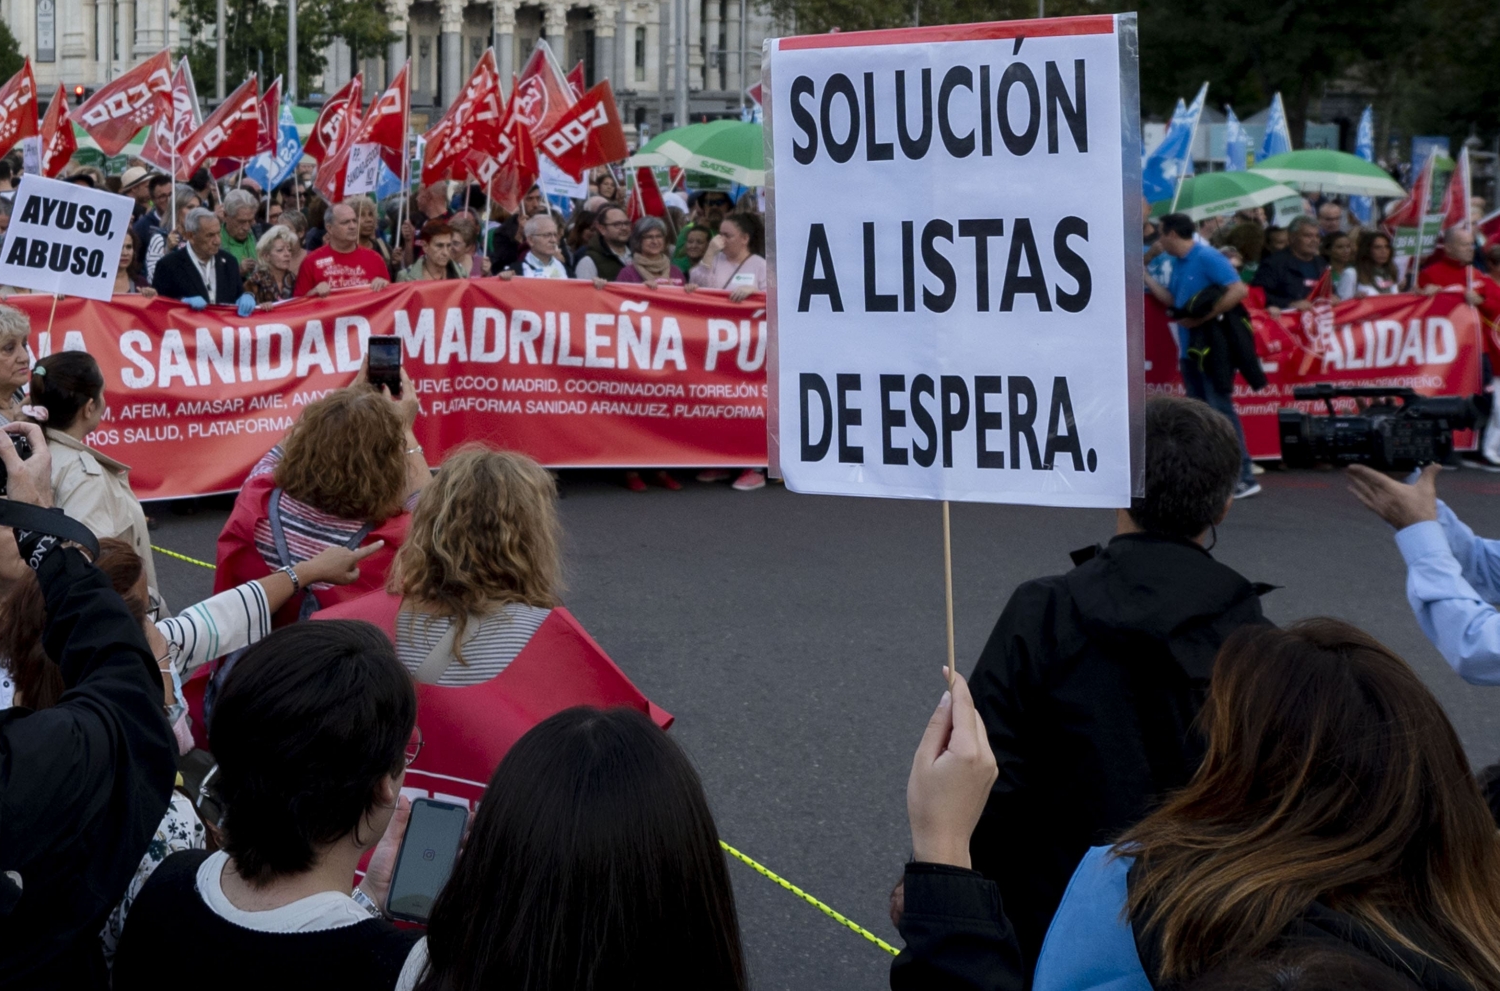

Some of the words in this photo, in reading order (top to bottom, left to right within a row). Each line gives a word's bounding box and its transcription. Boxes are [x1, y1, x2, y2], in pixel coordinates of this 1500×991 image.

[789, 35, 1089, 165] SOLUCIÓN
[699, 159, 737, 176] SATSE
[19, 194, 115, 241] AYUSO,
[5, 236, 108, 280] ABUSO.
[797, 222, 845, 313] A
[862, 215, 1093, 314] LISTAS
[119, 315, 371, 389] SANIDAD
[393, 300, 687, 371] MADRILEÑA
[704, 309, 767, 372] PÚ
[1323, 317, 1458, 370] ALIDAD
[85, 430, 120, 447] ROS
[123, 425, 184, 442] SALUD,
[188, 416, 294, 438] PLATAFORMA
[432, 397, 520, 415] PLATAFORMA
[526, 400, 587, 414] SANIDAD
[590, 401, 671, 418] ARANJUEZ,
[674, 404, 765, 419] PLATAFORMA
[120, 403, 170, 421] AFEM,
[175, 398, 245, 417] AMASAP,
[249, 394, 288, 411] AME,
[292, 388, 334, 405] AMY
[412, 379, 454, 394] UEVE,
[455, 376, 498, 392] CCOO
[502, 378, 562, 394] MADRID,
[565, 379, 684, 397] COORDINADORA
[689, 382, 758, 398] TORREJÓN
[799, 372, 865, 465] DE
[879, 373, 1099, 473] ESPERA.
[29, 533, 58, 570] ONY
